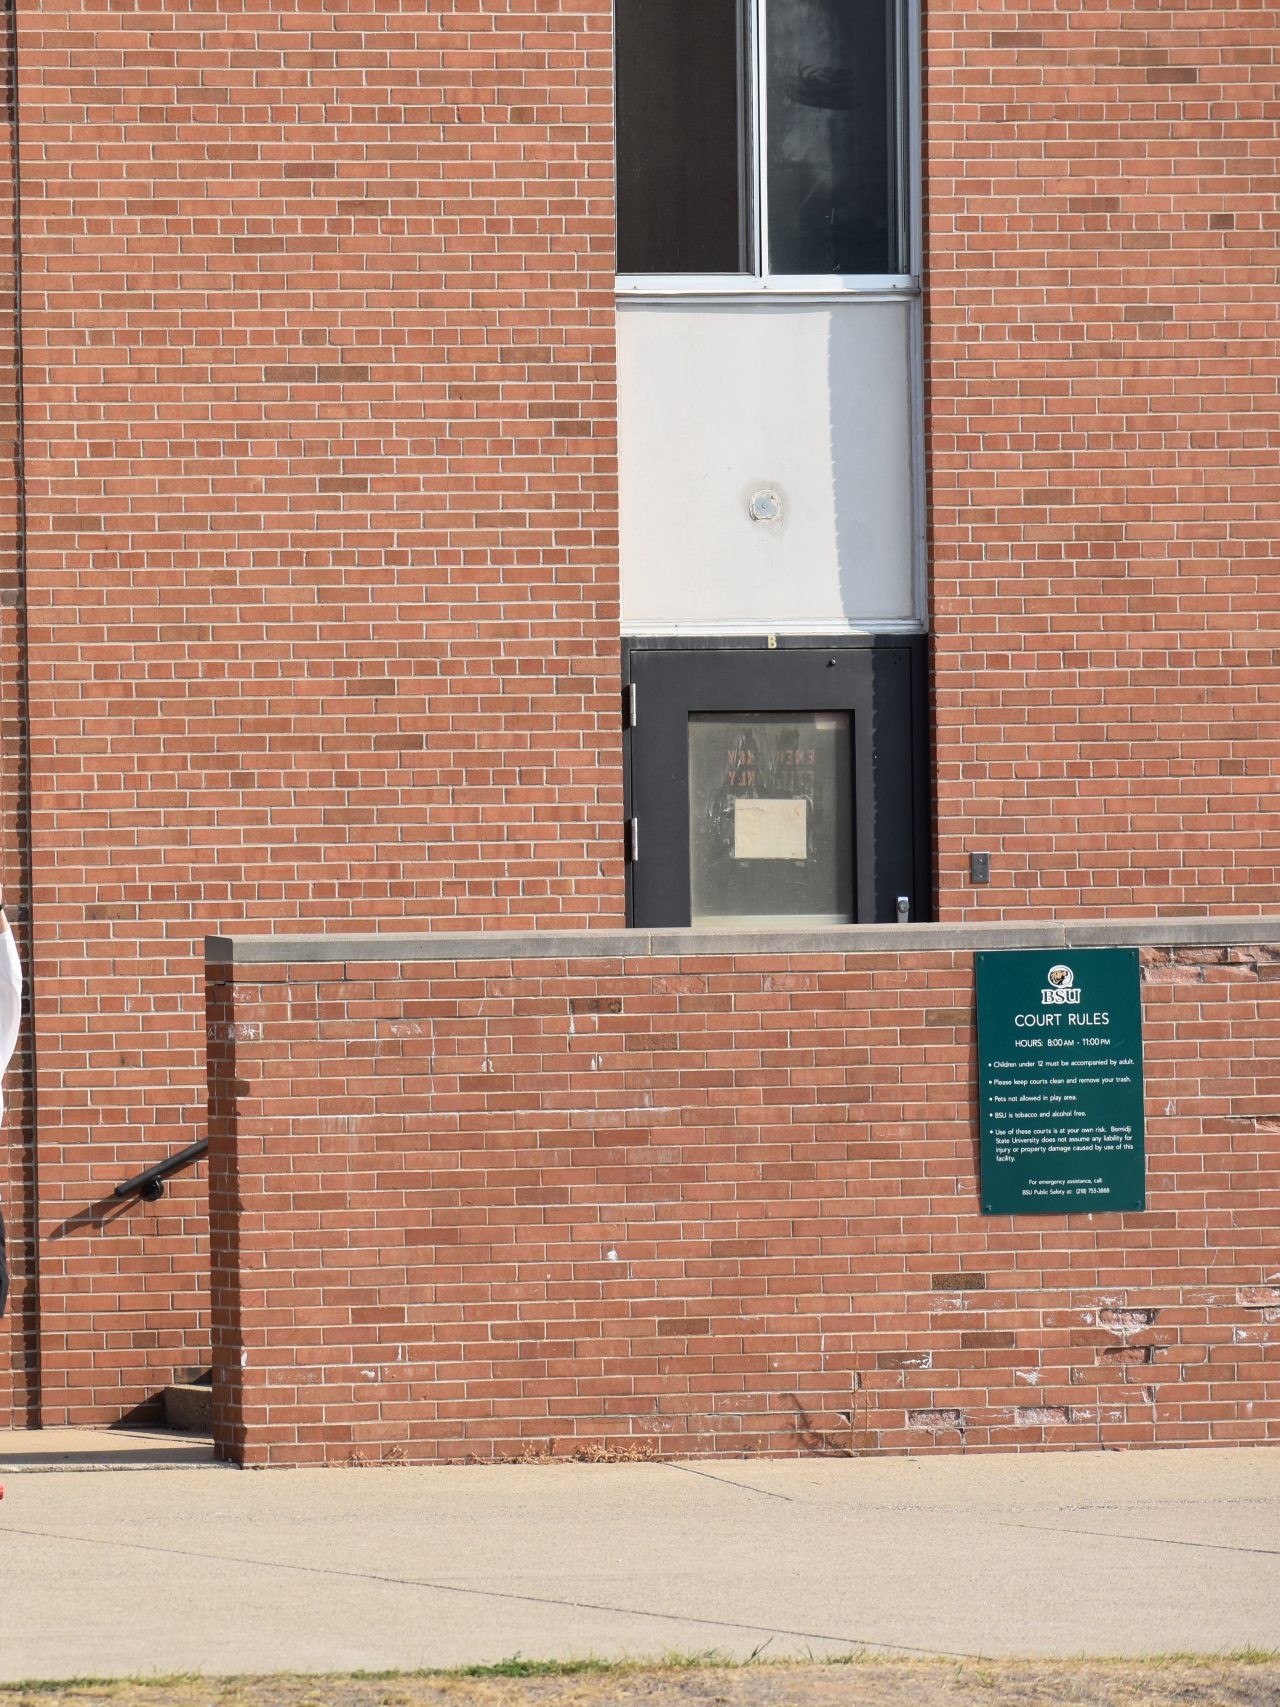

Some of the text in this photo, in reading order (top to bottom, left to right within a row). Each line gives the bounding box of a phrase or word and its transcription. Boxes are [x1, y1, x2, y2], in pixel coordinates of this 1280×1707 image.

[767, 634, 777, 648] B
[1041, 988, 1081, 1004] BSU
[1014, 1012, 1110, 1027] COURT RULES
[1015, 1039, 1043, 1048] HOURS:
[994, 1060, 1017, 1068] Children
[1070, 1059, 1108, 1067] accompanied
[1110, 1058, 1117, 1067] by
[1014, 1078, 1028, 1087] keep
[1020, 1094, 1041, 1102] allowed
[1050, 1094, 1061, 1102] play
[1111, 1126, 1131, 1134] Bemidji
[1104, 1135, 1123, 1143] liability
[1021, 1146, 1046, 1154] property
[1048, 1145, 1071, 1153] damage
[1094, 1144, 1102, 1152] by
[996, 1155, 1015, 1163] facility.
[1050, 1188, 1066, 1196] Safety
